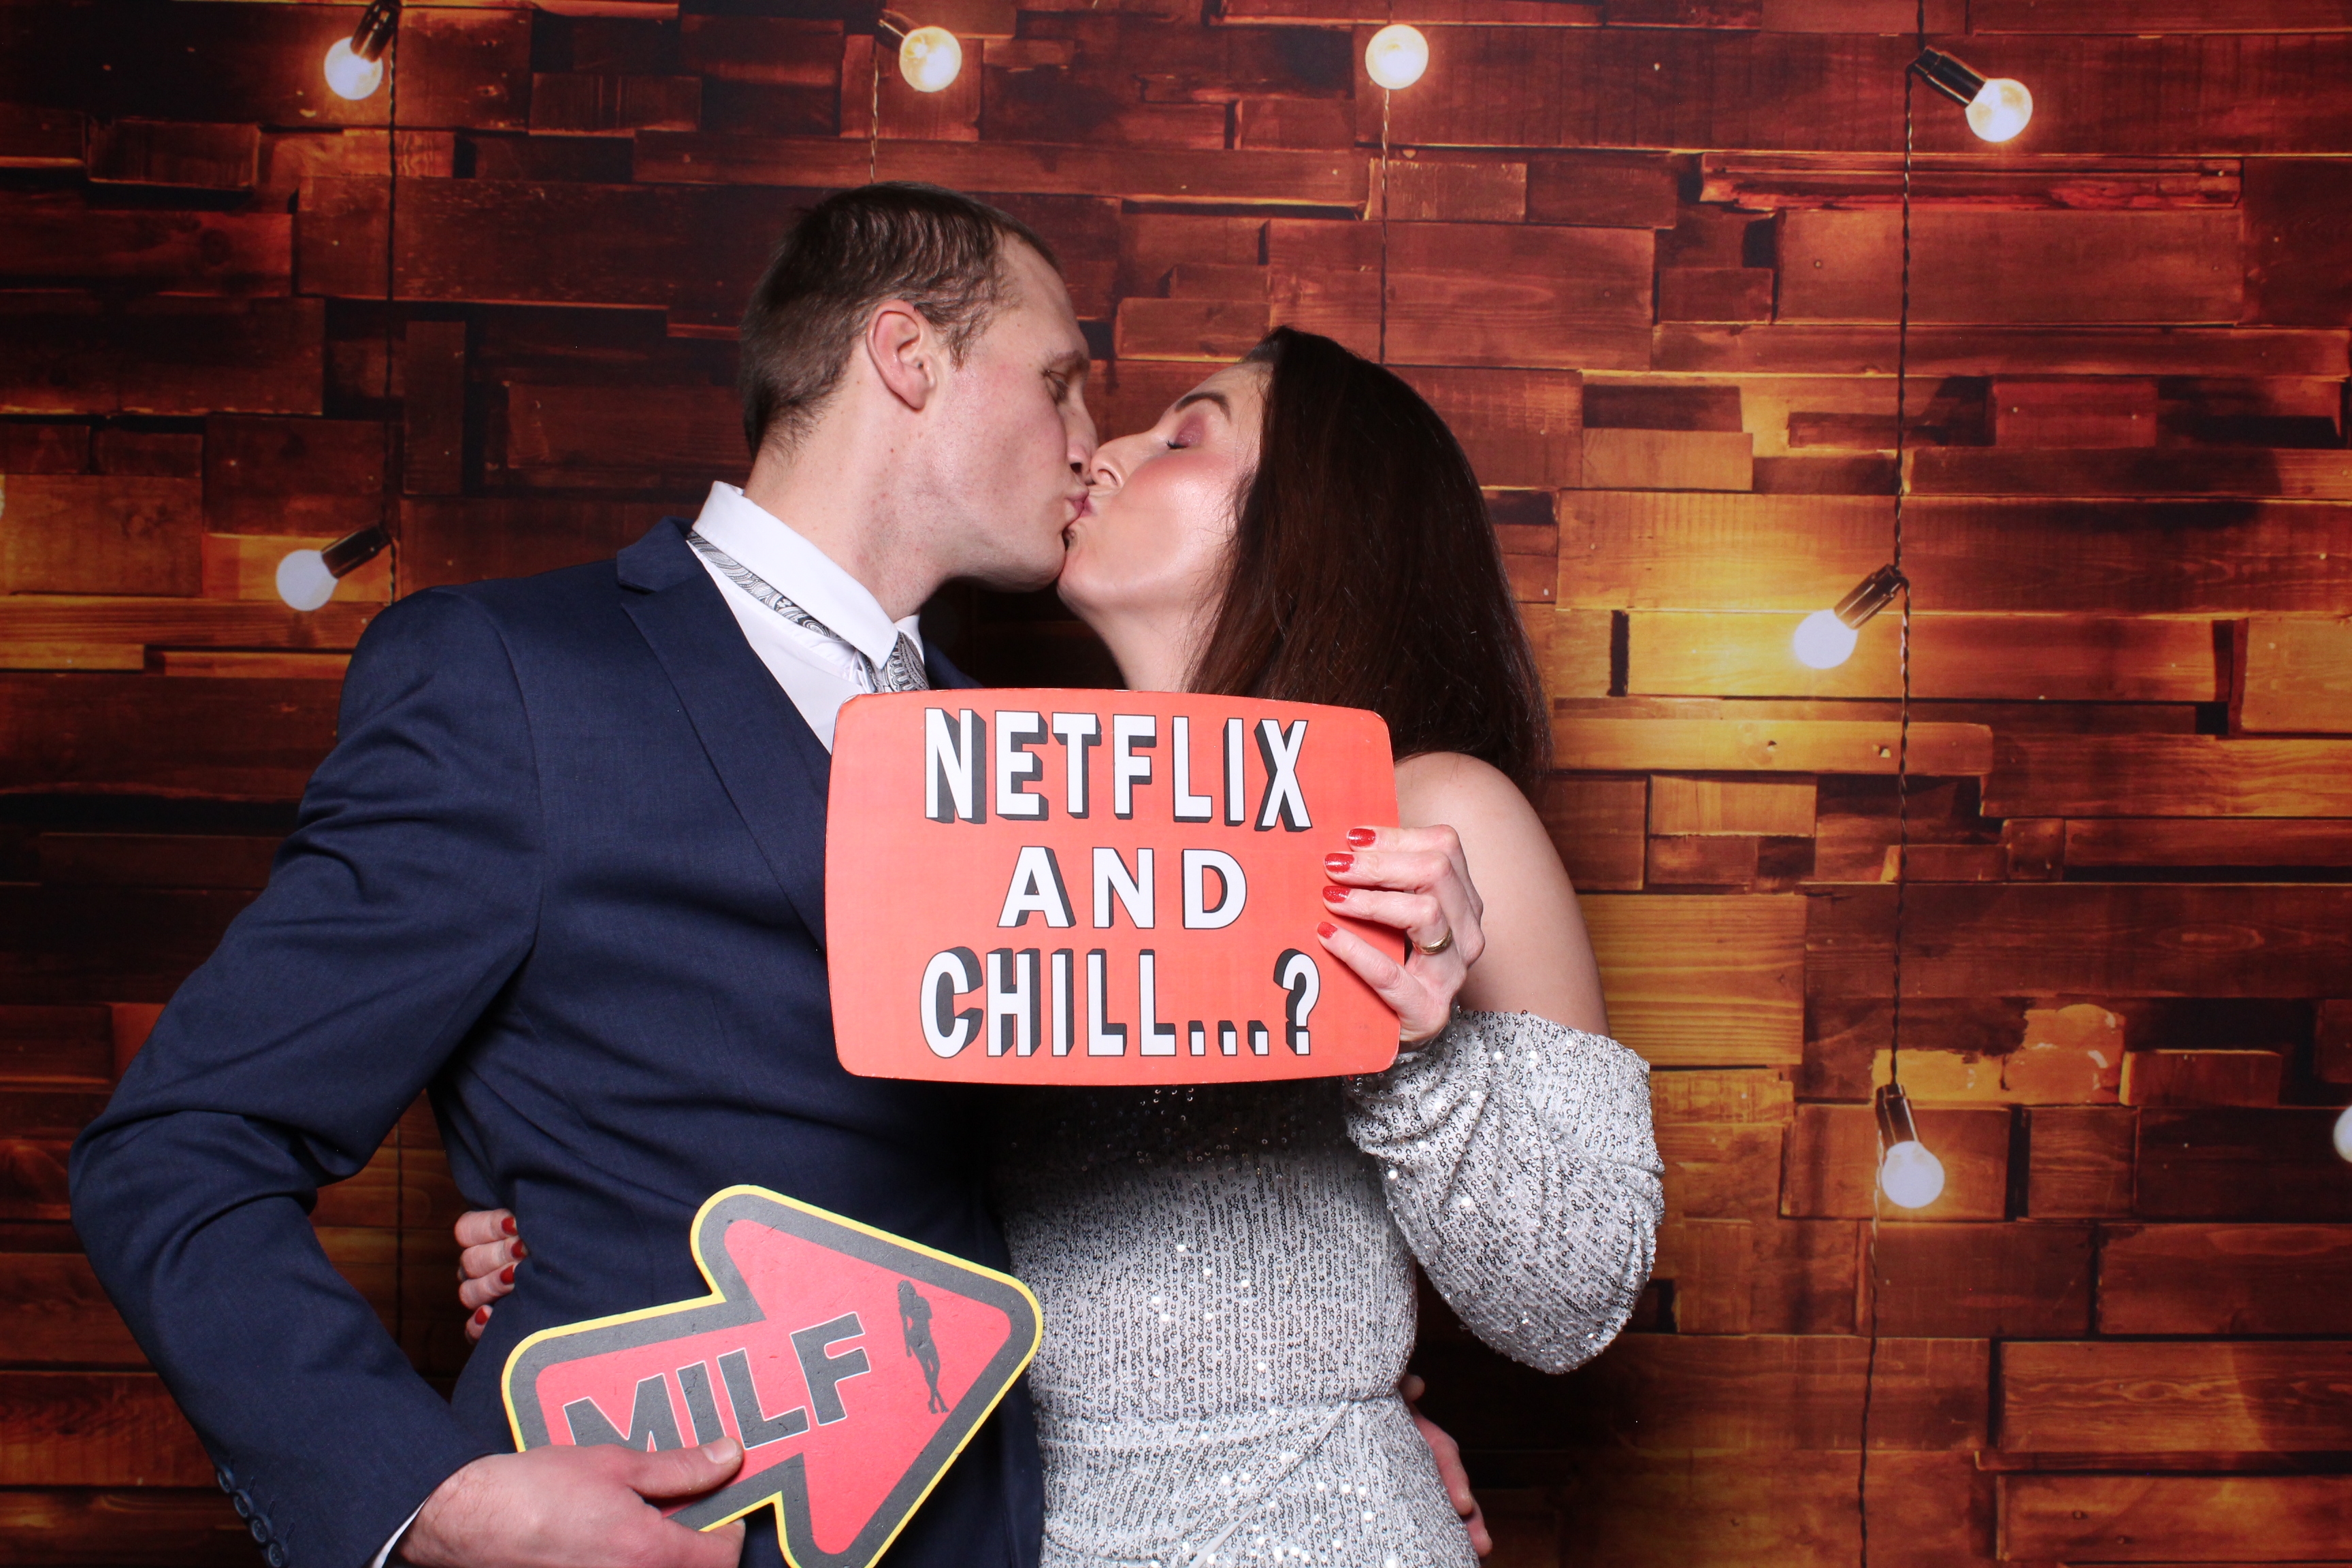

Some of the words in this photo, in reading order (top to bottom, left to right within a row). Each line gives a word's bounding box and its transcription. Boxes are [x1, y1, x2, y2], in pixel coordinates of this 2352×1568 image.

[924, 707, 1313, 832] NETFLIX
[996, 846, 1247, 930] AND
[919, 946, 1321, 1059] CHILL...?
[563, 1311, 871, 1452] MILF
